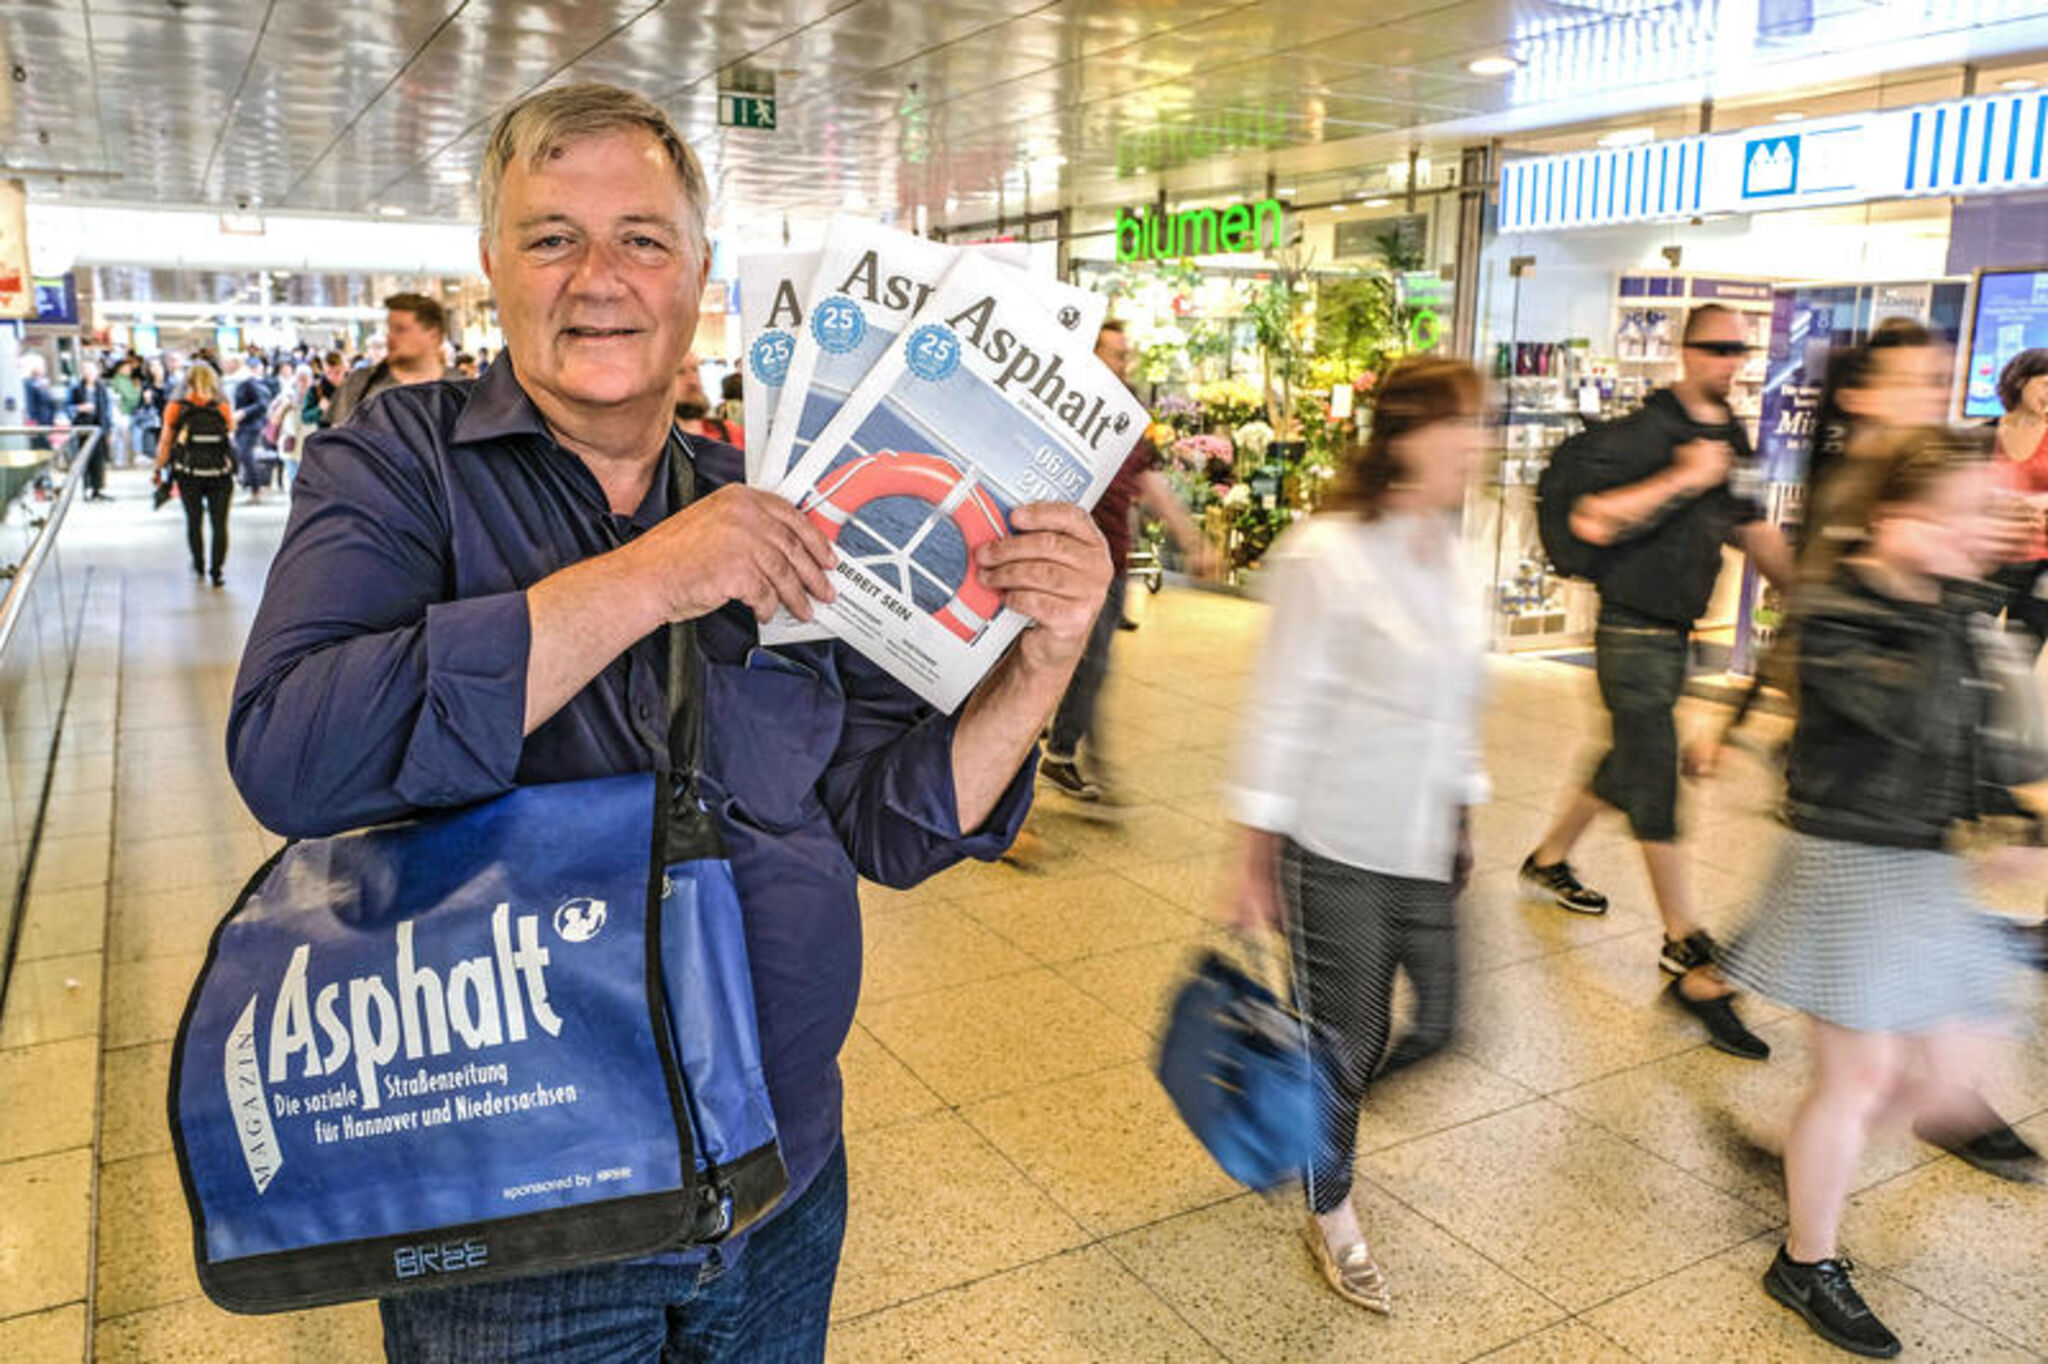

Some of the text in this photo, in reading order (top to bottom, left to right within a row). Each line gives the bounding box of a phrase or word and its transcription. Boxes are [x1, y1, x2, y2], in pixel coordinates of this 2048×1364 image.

[1116, 199, 1281, 263] blumen
[824, 307, 853, 329] 25
[919, 333, 952, 360] 25
[760, 339, 790, 365] 25
[945, 296, 1112, 450] Asphalt
[837, 561, 882, 598] BEREIT
[880, 594, 913, 621] SEIN
[268, 902, 563, 1110] Asphalt
[237, 1033, 271, 1186] MAGAZIN
[272, 1062, 509, 1118] Die soziale Straßenzeitung
[315, 1082, 578, 1144] für Hannover und Niedersachsen
[503, 1175, 573, 1200] sponsored
[575, 1174, 592, 1188] by
